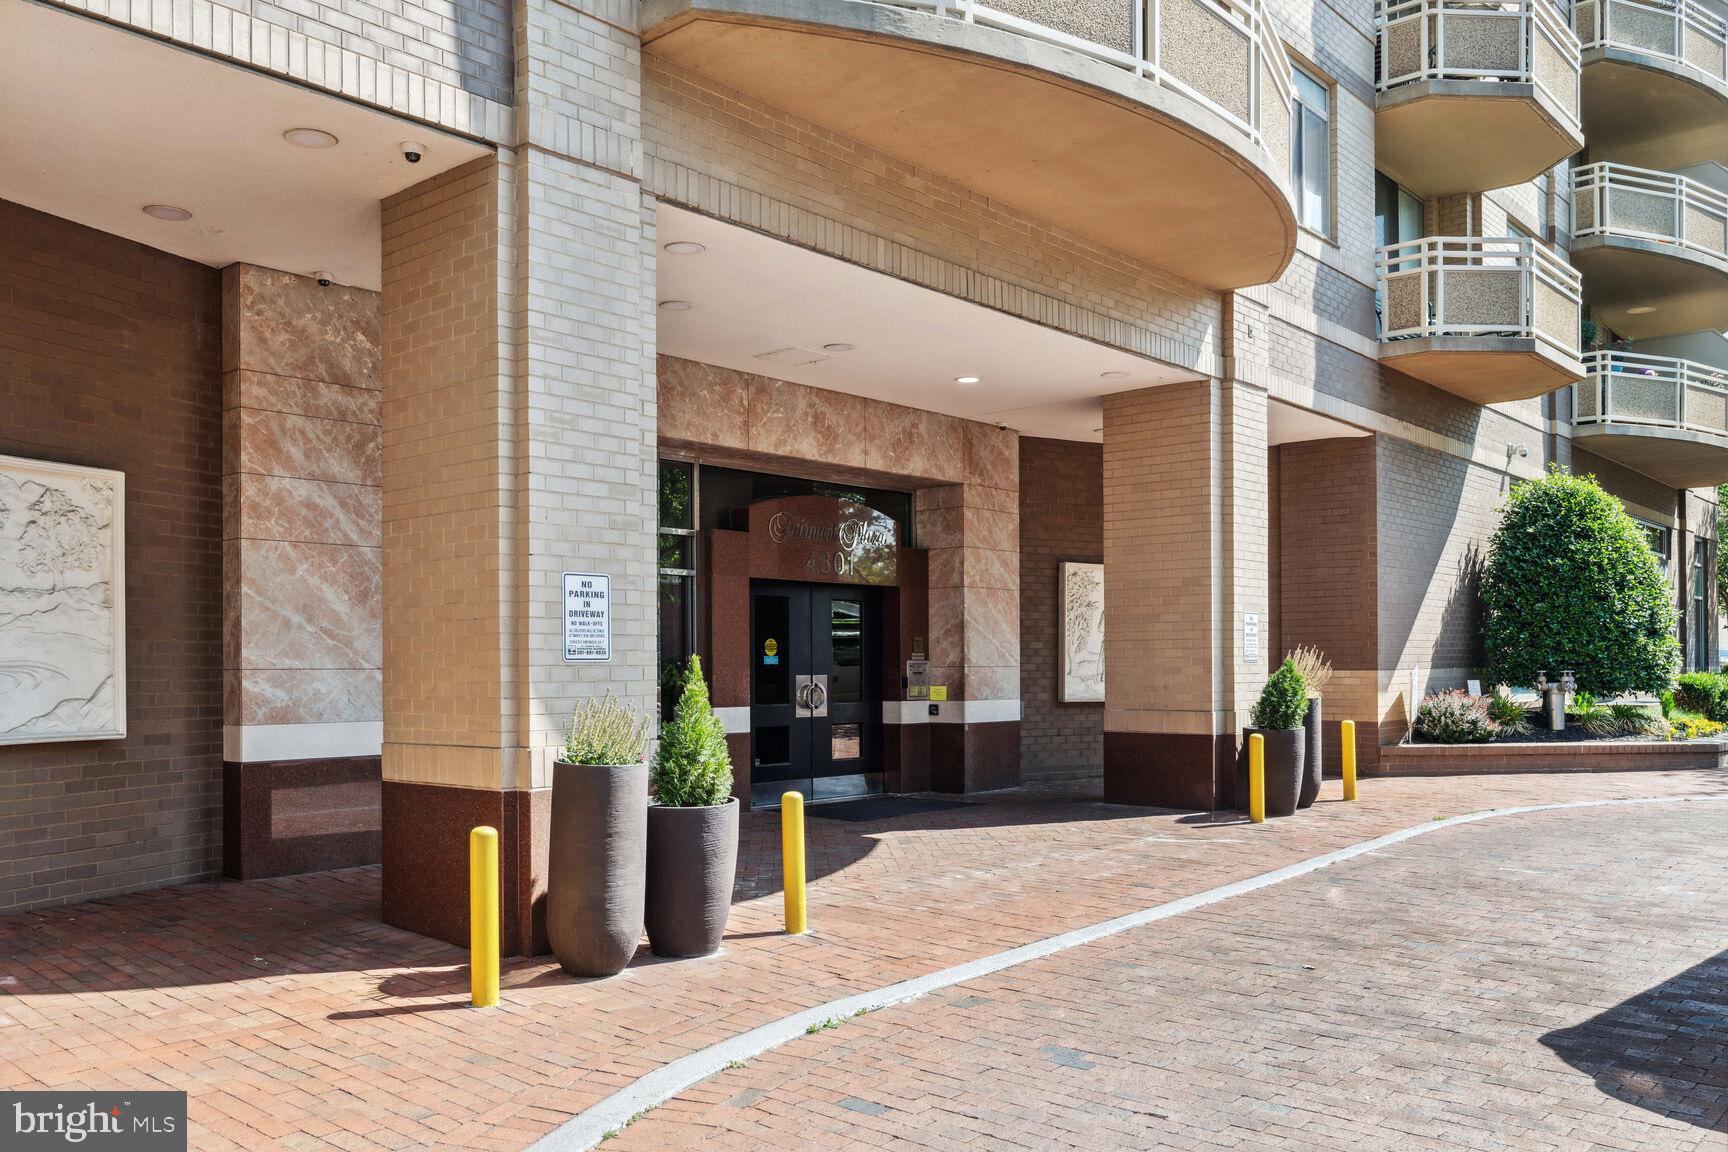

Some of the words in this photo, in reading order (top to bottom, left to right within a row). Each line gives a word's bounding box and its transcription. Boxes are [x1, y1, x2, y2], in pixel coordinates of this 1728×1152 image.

[769, 511, 840, 544] Fairmont
[839, 518, 887, 550] Plaza
[806, 551, 855, 576] 4301
[581, 581, 593, 589] NO
[569, 590, 605, 599] PARKING
[583, 600, 591, 608] IN
[568, 610, 605, 618] DRIVEWAY
